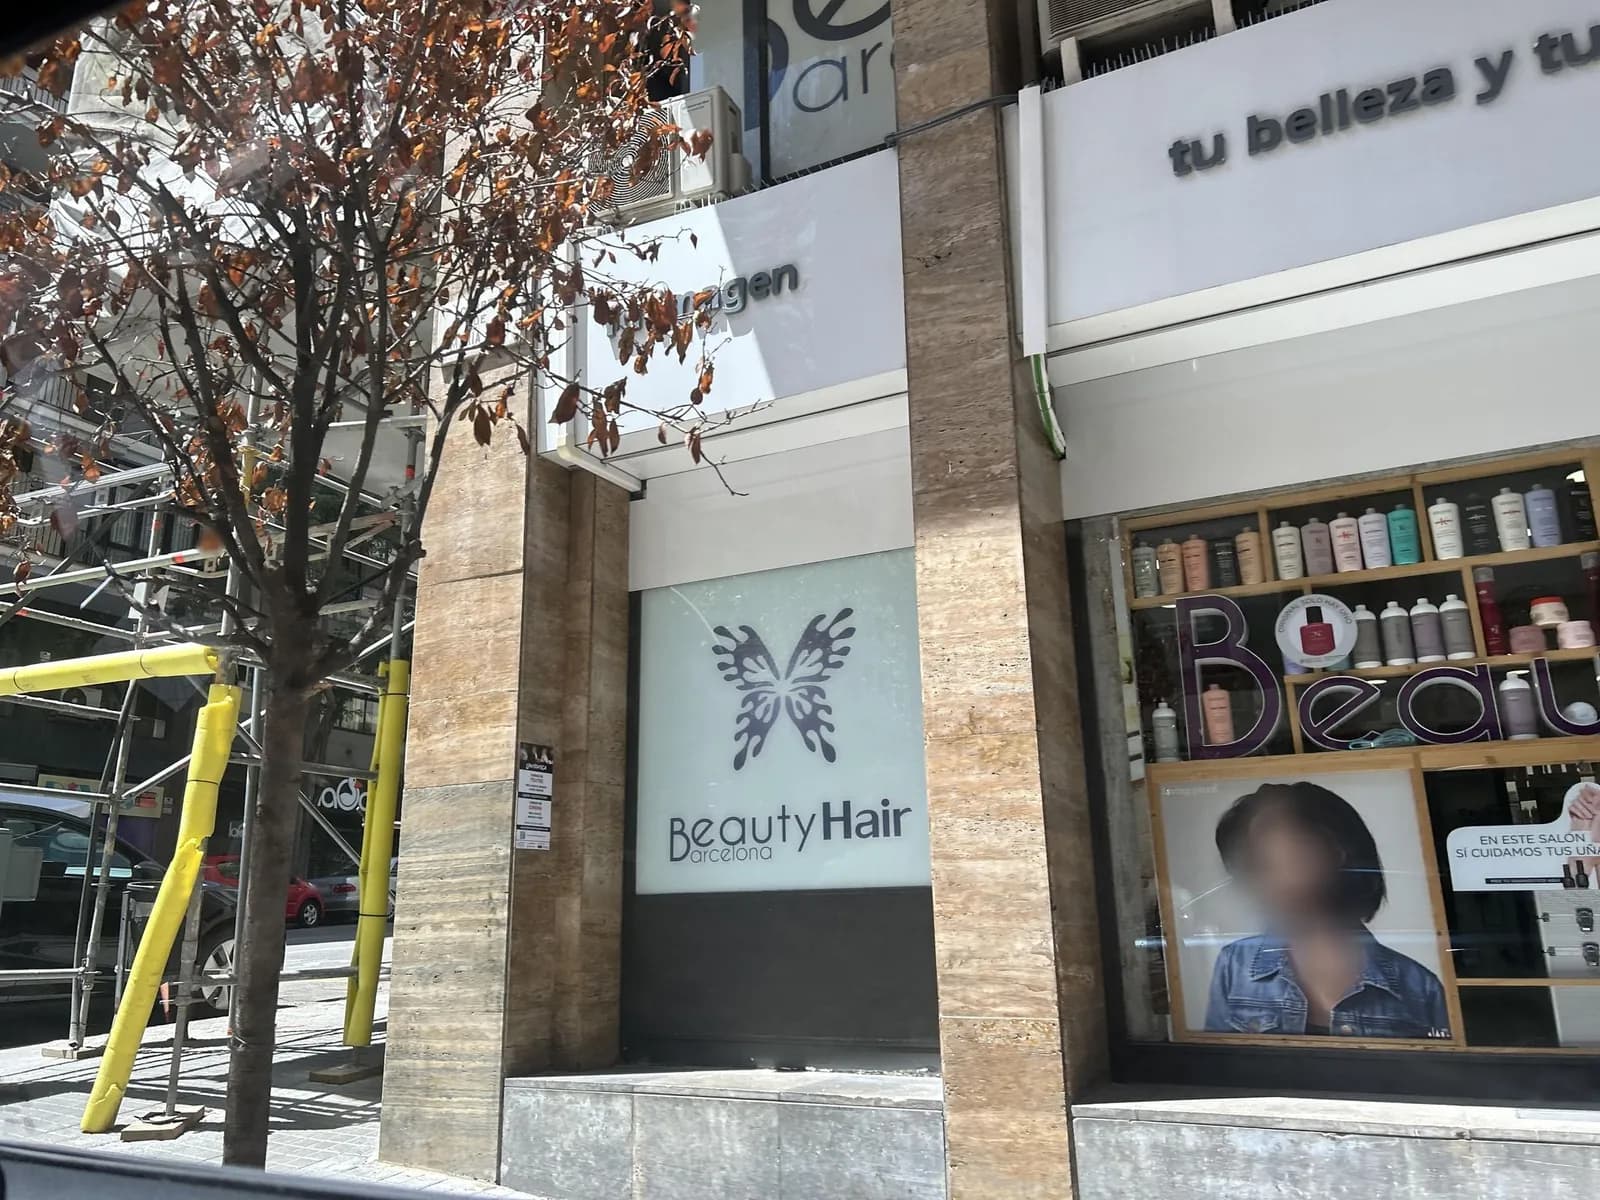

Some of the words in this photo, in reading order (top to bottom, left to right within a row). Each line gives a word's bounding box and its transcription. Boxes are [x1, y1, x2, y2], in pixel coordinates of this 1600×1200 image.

[1168, 132, 1226, 178] tu
[1246, 65, 1457, 157] belleza
[1474, 49, 1515, 106] y
[1532, 23, 1600, 75] tu
[1480, 835, 1498, 845] EN
[1502, 834, 1535, 845] ESTE
[1471, 847, 1541, 858] CUIDAMOS
[1547, 846, 1572, 856] TUS
